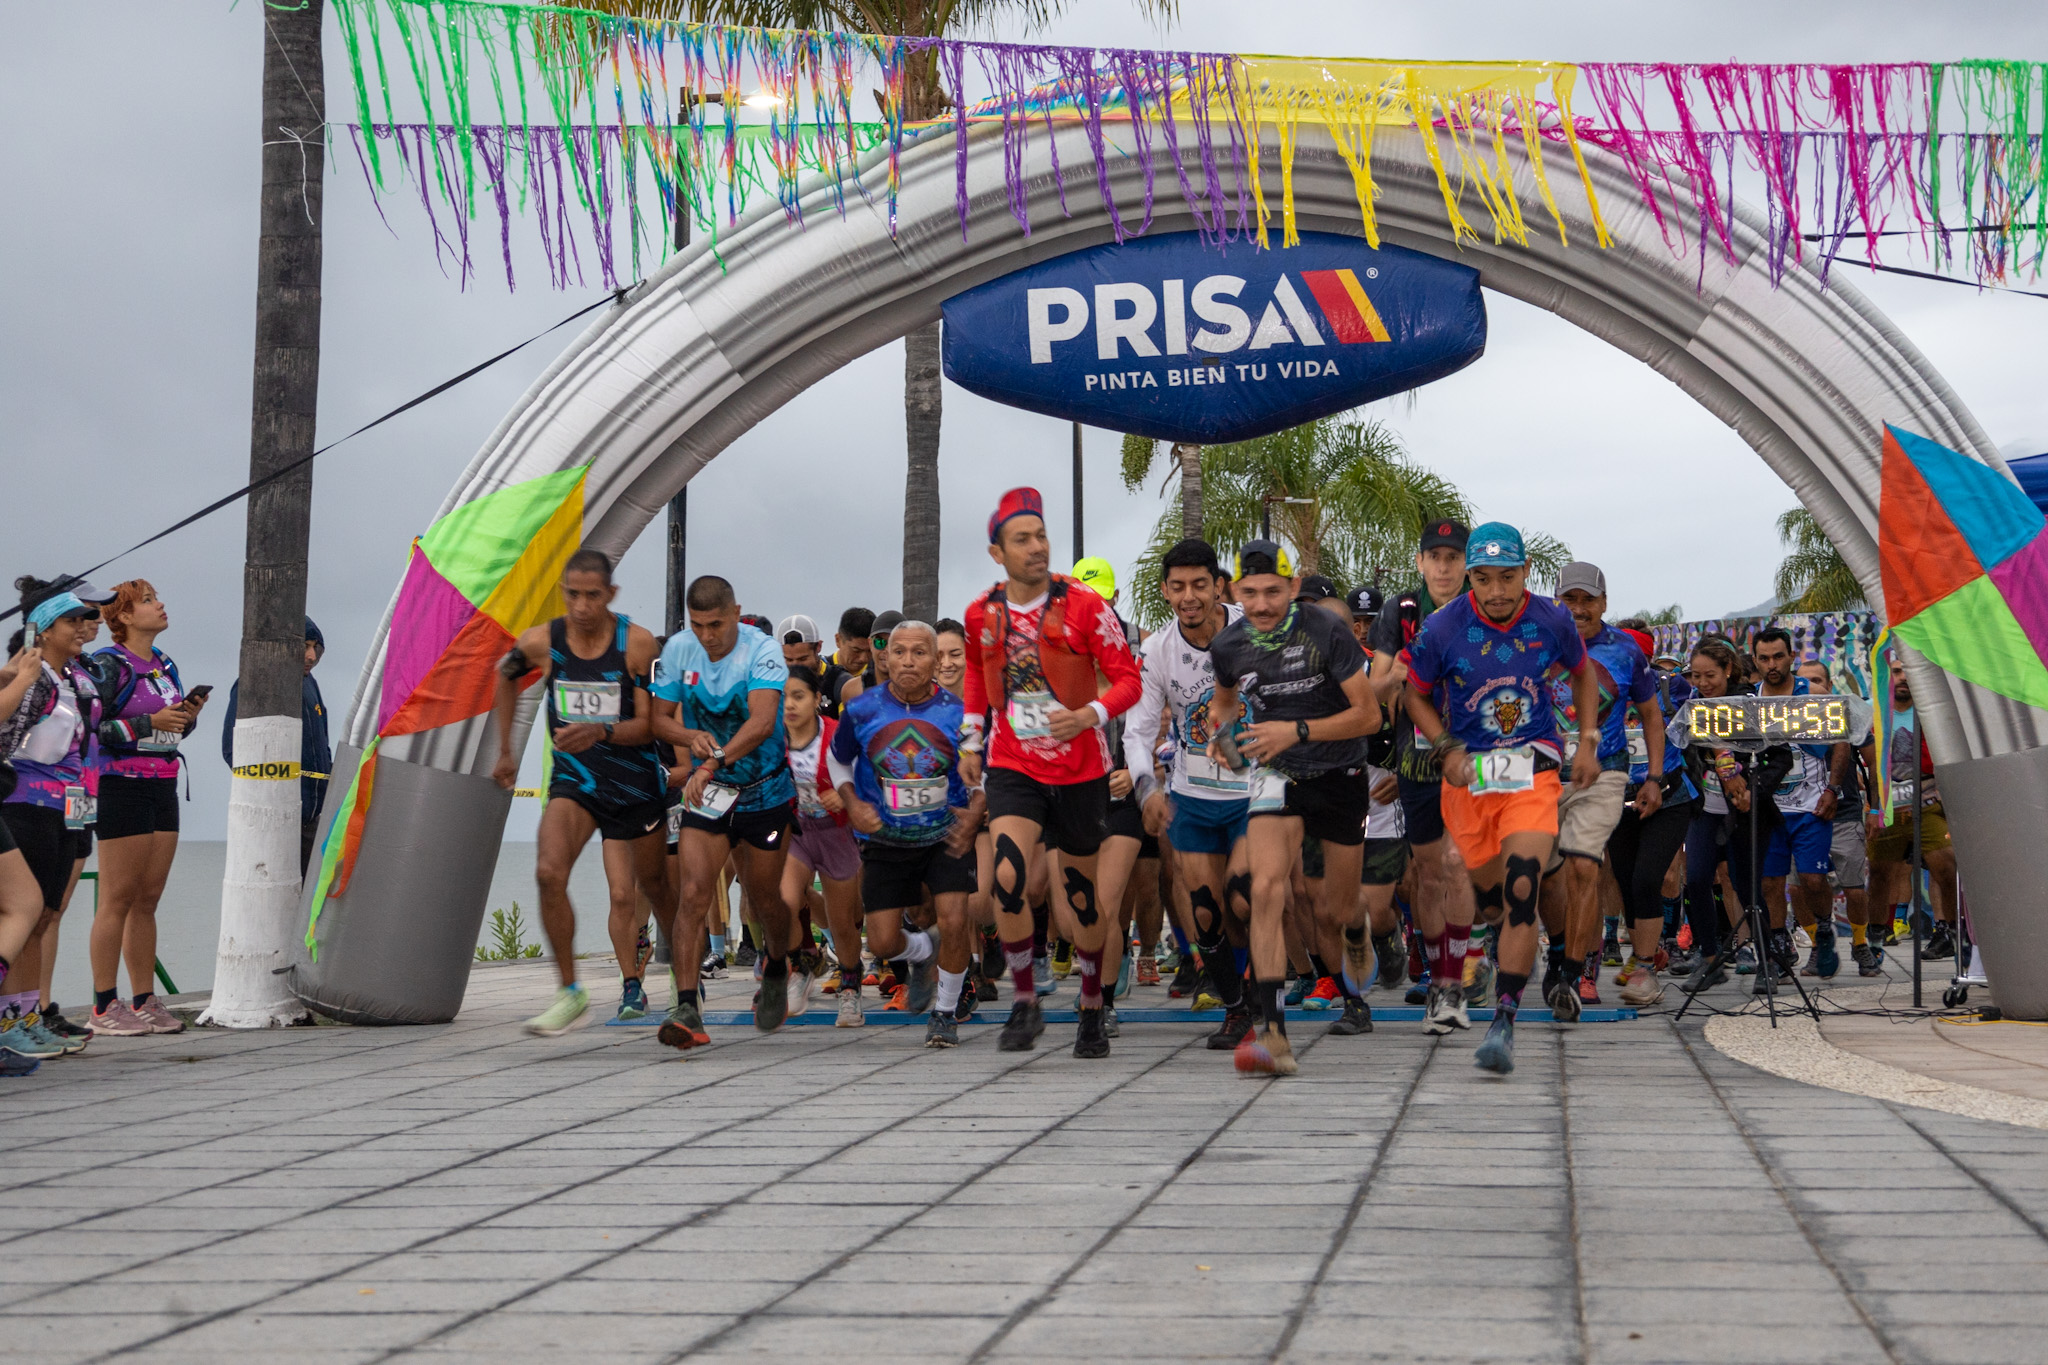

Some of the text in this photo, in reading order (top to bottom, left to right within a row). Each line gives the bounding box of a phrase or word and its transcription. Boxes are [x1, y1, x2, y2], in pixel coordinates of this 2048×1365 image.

[1027, 273, 1326, 364] PRISA
[1084, 359, 1339, 391] PINTA BIEN TU VIDA
[573, 692, 602, 715] 49
[1486, 754, 1512, 780] 12
[704, 787, 721, 807] 4
[903, 787, 932, 808] 36
